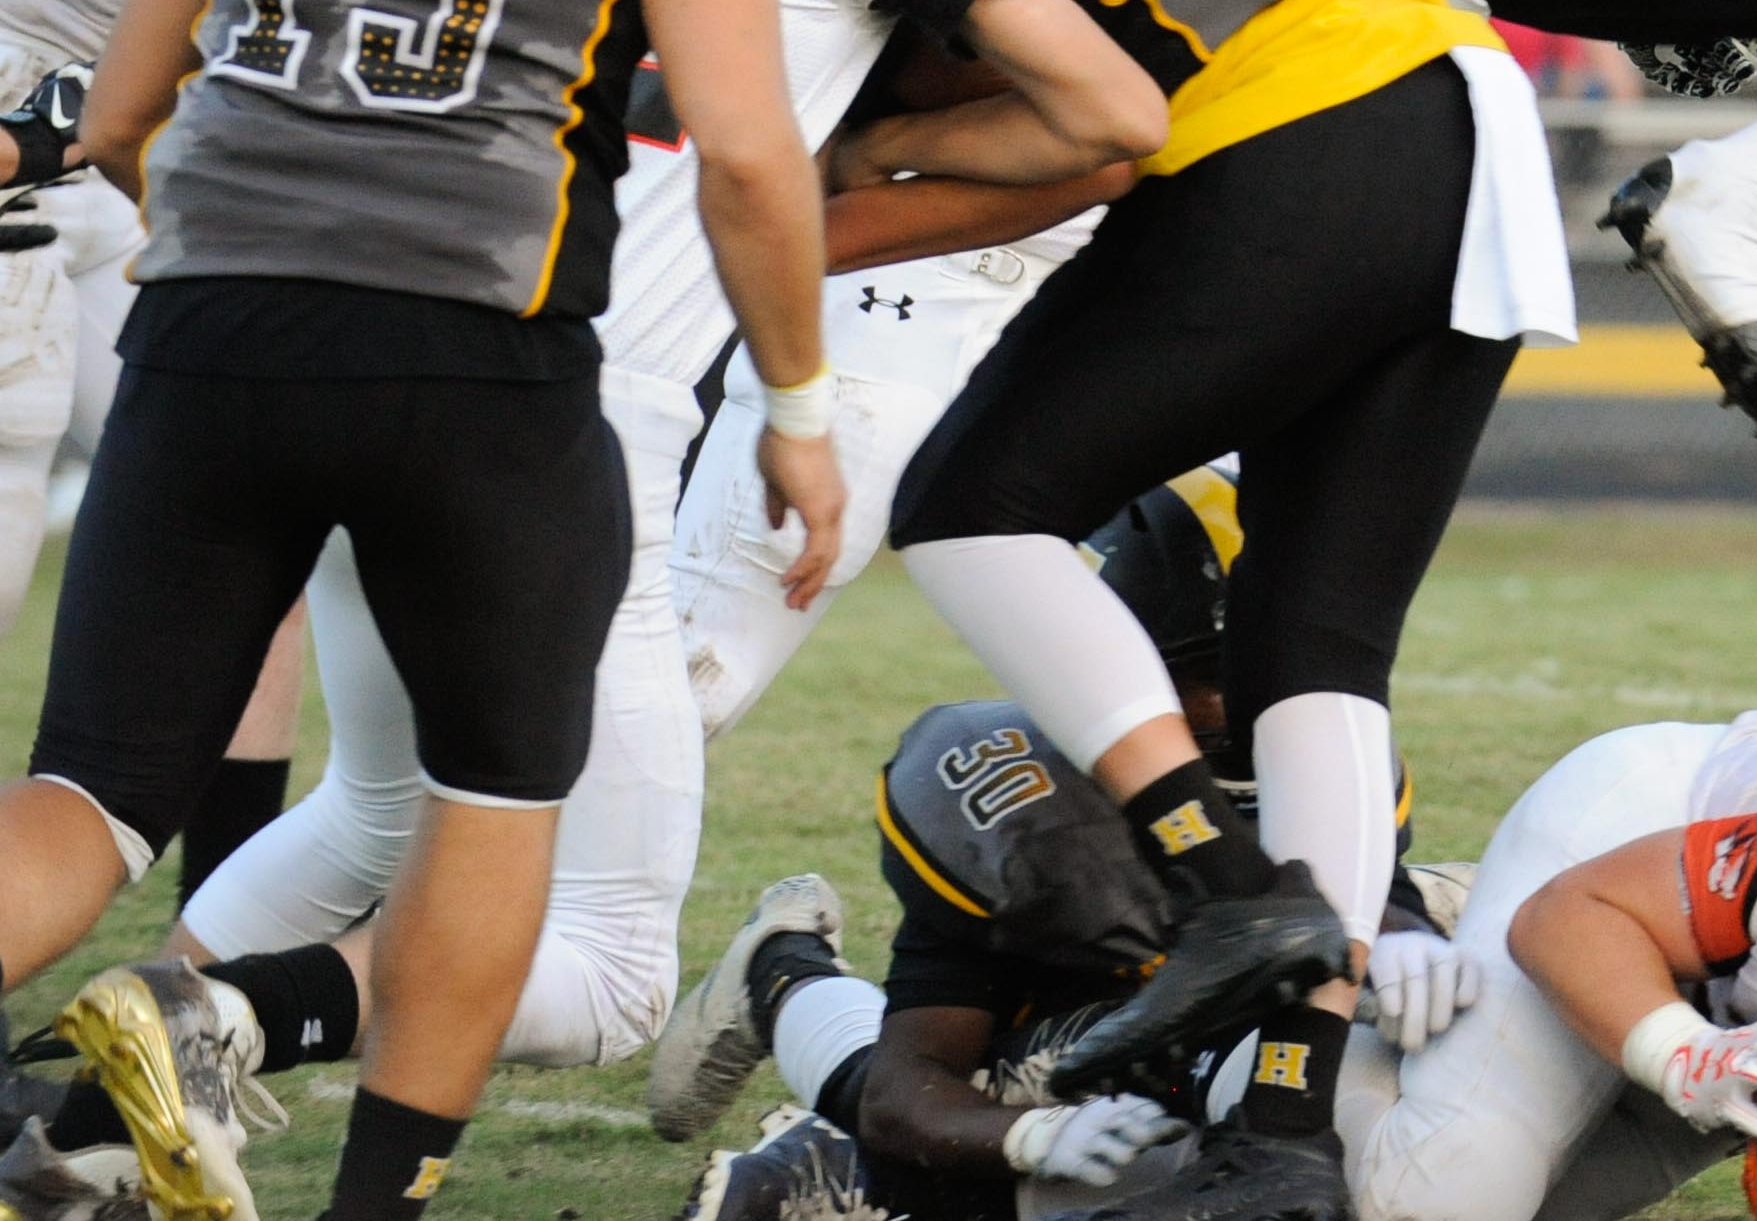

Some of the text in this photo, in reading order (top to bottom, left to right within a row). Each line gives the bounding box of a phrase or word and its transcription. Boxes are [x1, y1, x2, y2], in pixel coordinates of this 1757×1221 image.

[936, 728, 1057, 831] 30
[1148, 799, 1222, 857] H
[1255, 1042, 1310, 1090] H
